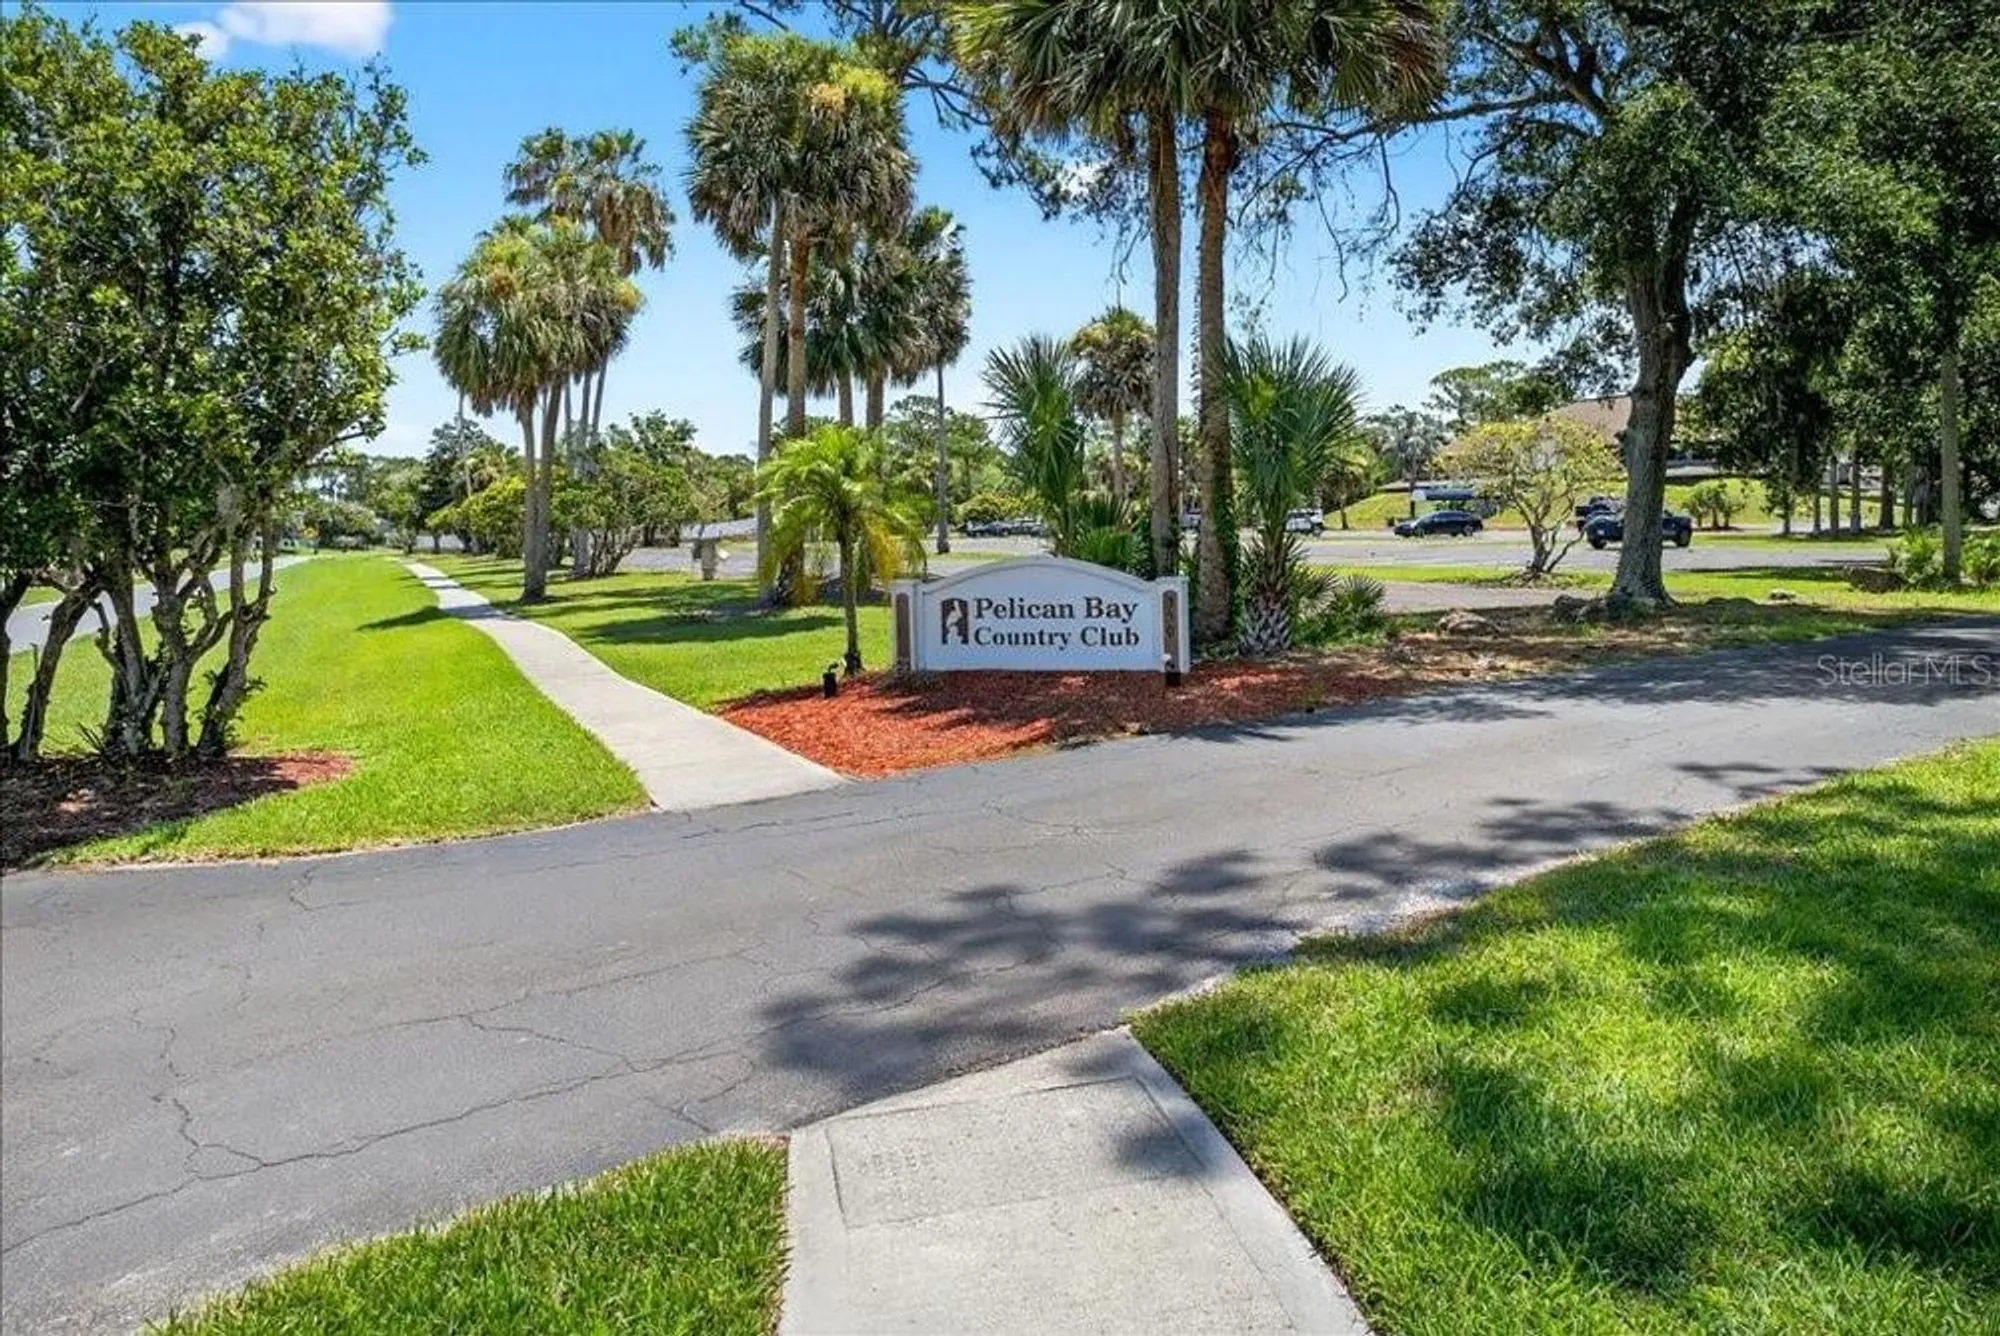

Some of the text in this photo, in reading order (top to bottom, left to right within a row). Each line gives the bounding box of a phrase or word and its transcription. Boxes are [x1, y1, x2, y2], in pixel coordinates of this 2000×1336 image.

[974, 597, 1075, 619] Pelican
[1083, 596, 1138, 623] Bay
[974, 626, 1139, 651] Country Club
